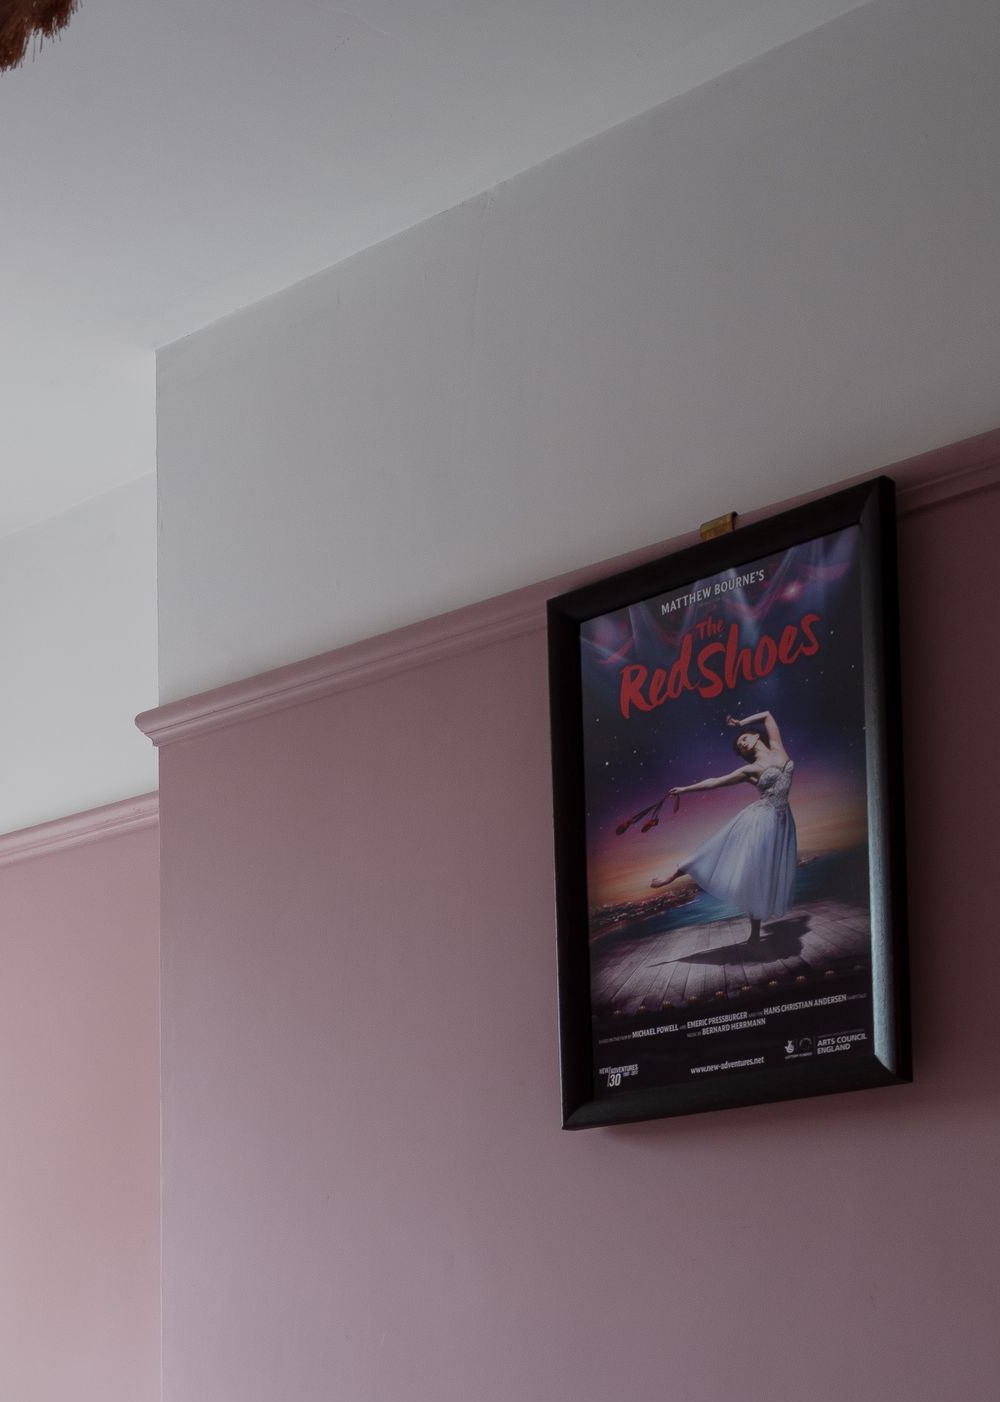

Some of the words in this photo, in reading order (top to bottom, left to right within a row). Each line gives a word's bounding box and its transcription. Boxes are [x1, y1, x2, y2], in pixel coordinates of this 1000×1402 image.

[661, 586, 712, 616] MATTHEW
[714, 569, 765, 596] BOURNE'S
[695, 615, 725, 640] The
[620, 633, 699, 720] Red
[697, 613, 821, 699] Shoes
[632, 1028, 656, 1039] MICHAEL
[656, 1024, 679, 1035] POWELL
[687, 1018, 708, 1029] EMERIC
[708, 1011, 748, 1025] PRESSBURGER
[763, 1005, 780, 1016] HANS
[780, 1000, 813, 1013] CHRISTIAN
[813, 994, 847, 1007] ANDERSEN
[702, 1023, 730, 1036] BERNARD
[730, 1017, 766, 1031] HERRMANN
[817, 1038, 836, 1047] ARTS
[837, 1033, 868, 1044] COUNCIL
[817, 1043, 851, 1055] ENGLAND
[690, 1056, 765, 1074] www.new-adventures.net
